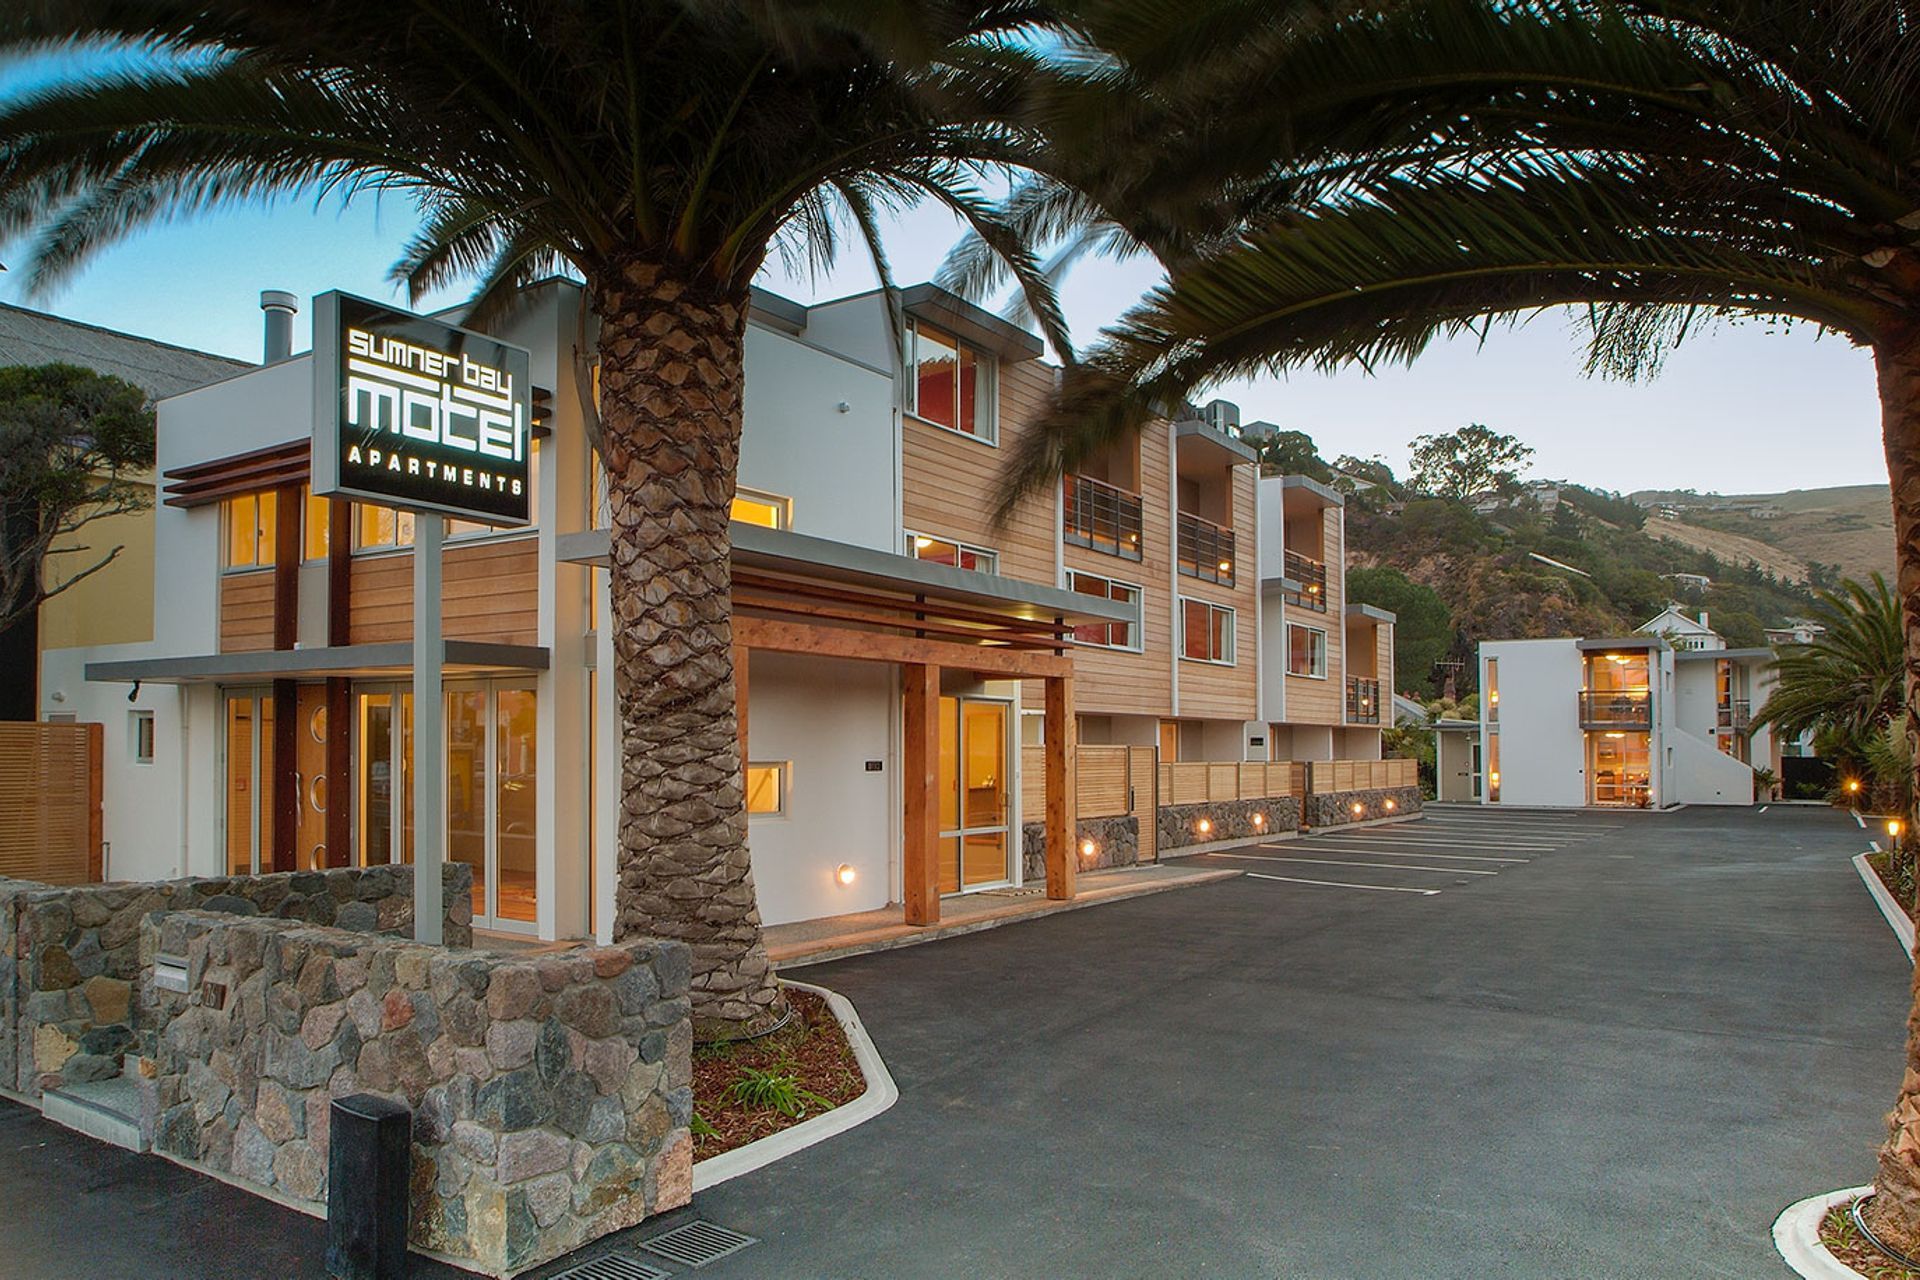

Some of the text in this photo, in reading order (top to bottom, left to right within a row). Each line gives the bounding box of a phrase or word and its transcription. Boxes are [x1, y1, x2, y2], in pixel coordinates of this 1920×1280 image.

[461, 353, 513, 411] bay
[348, 376, 523, 462] motel
[348, 445, 522, 496] APARTMENTS
